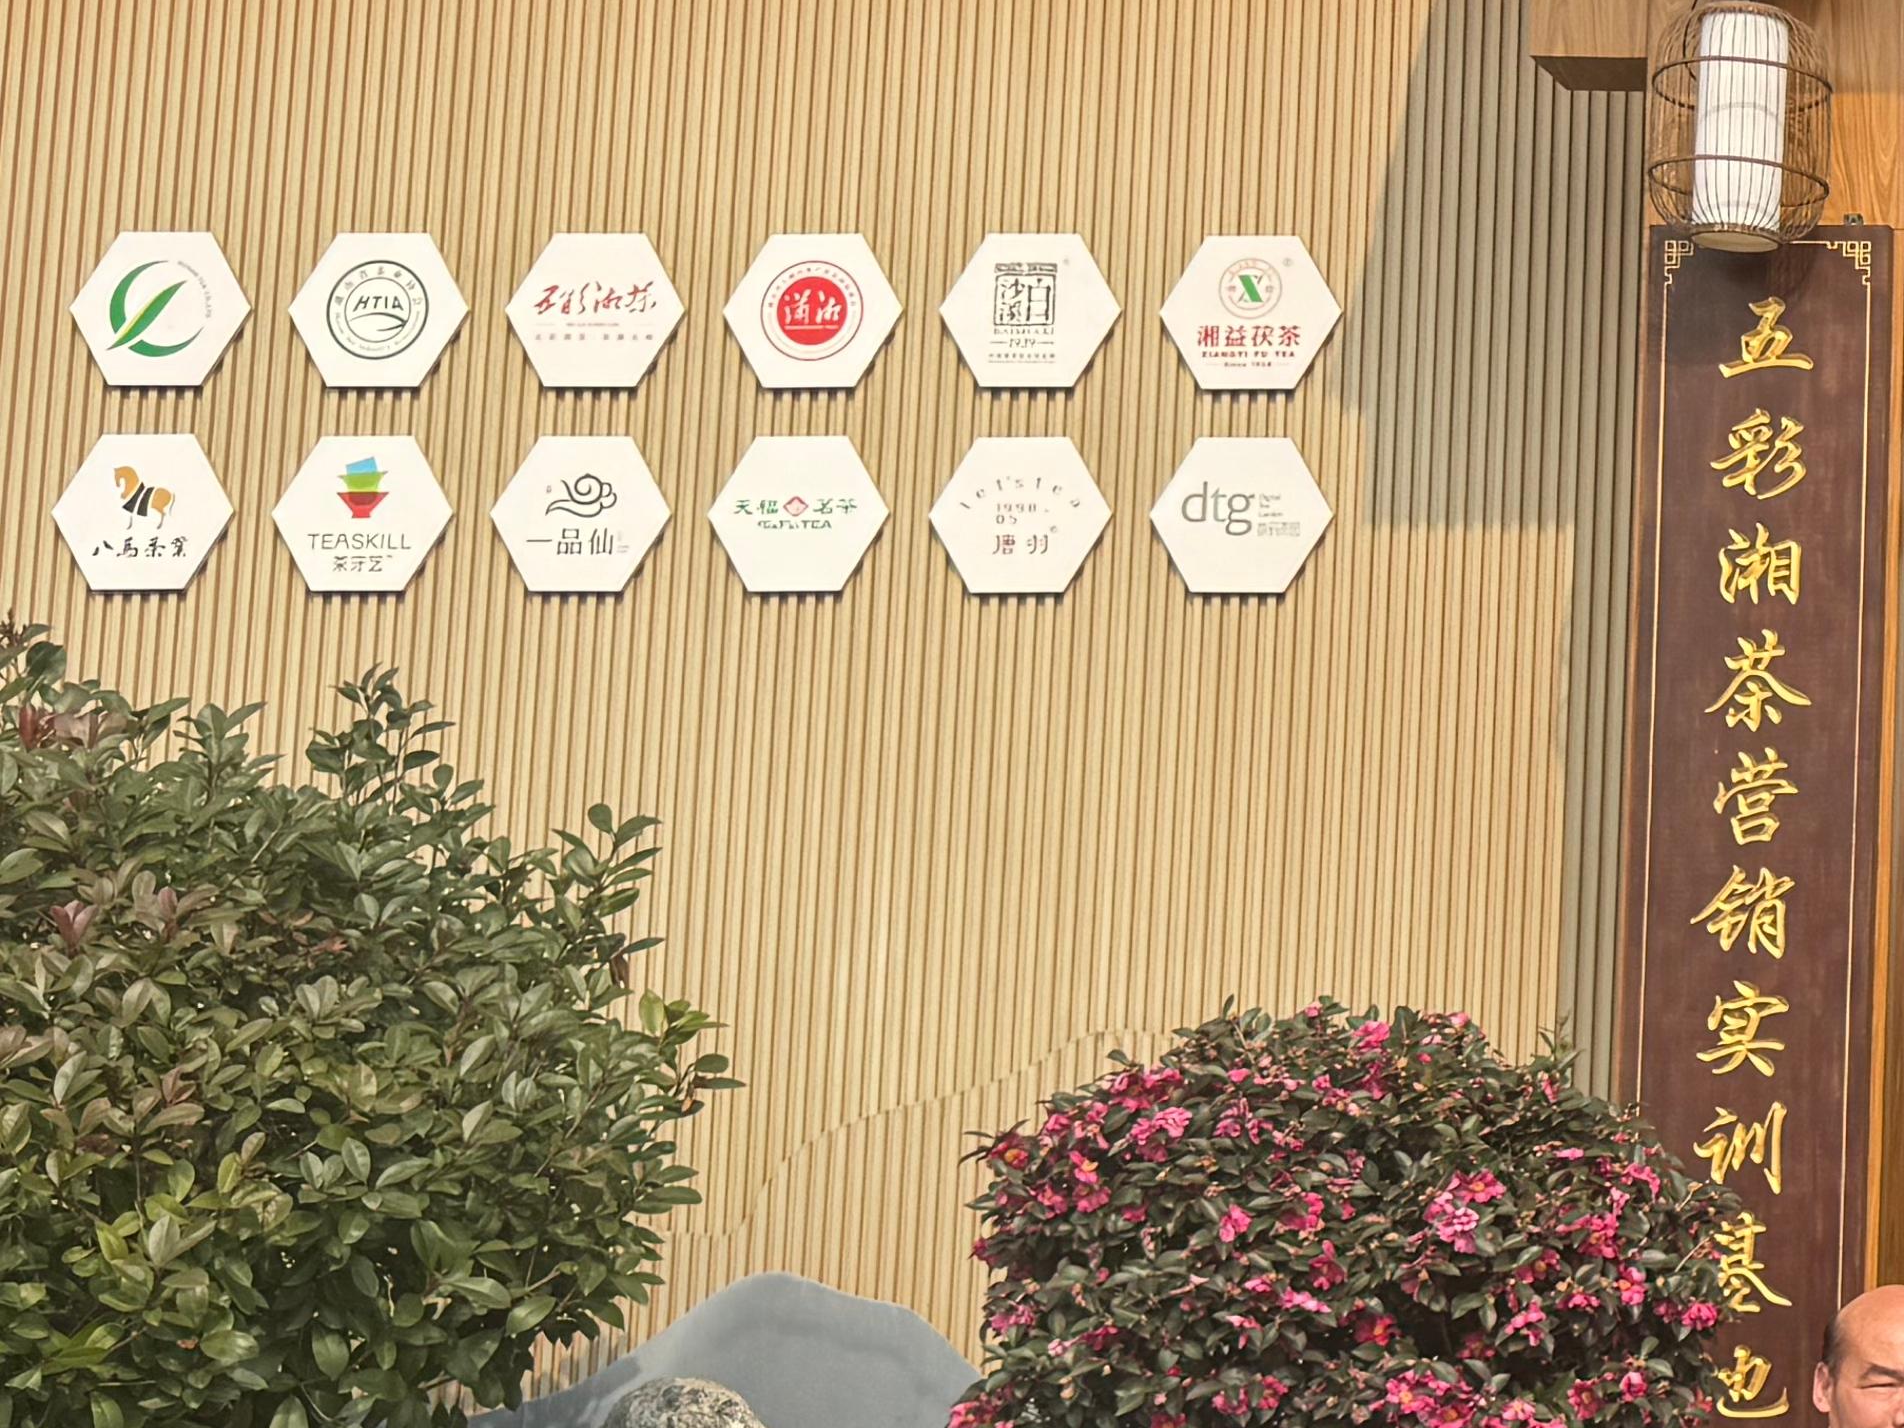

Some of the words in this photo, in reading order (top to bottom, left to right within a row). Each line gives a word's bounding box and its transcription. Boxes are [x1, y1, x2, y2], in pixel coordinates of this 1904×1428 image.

[352, 294, 405, 312] HTIA
[1197, 325, 1301, 347] 湘益茯茶
[1181, 481, 1256, 536] dtg
[307, 533, 412, 550] TEASKILL
[525, 527, 614, 555] 一品仙
